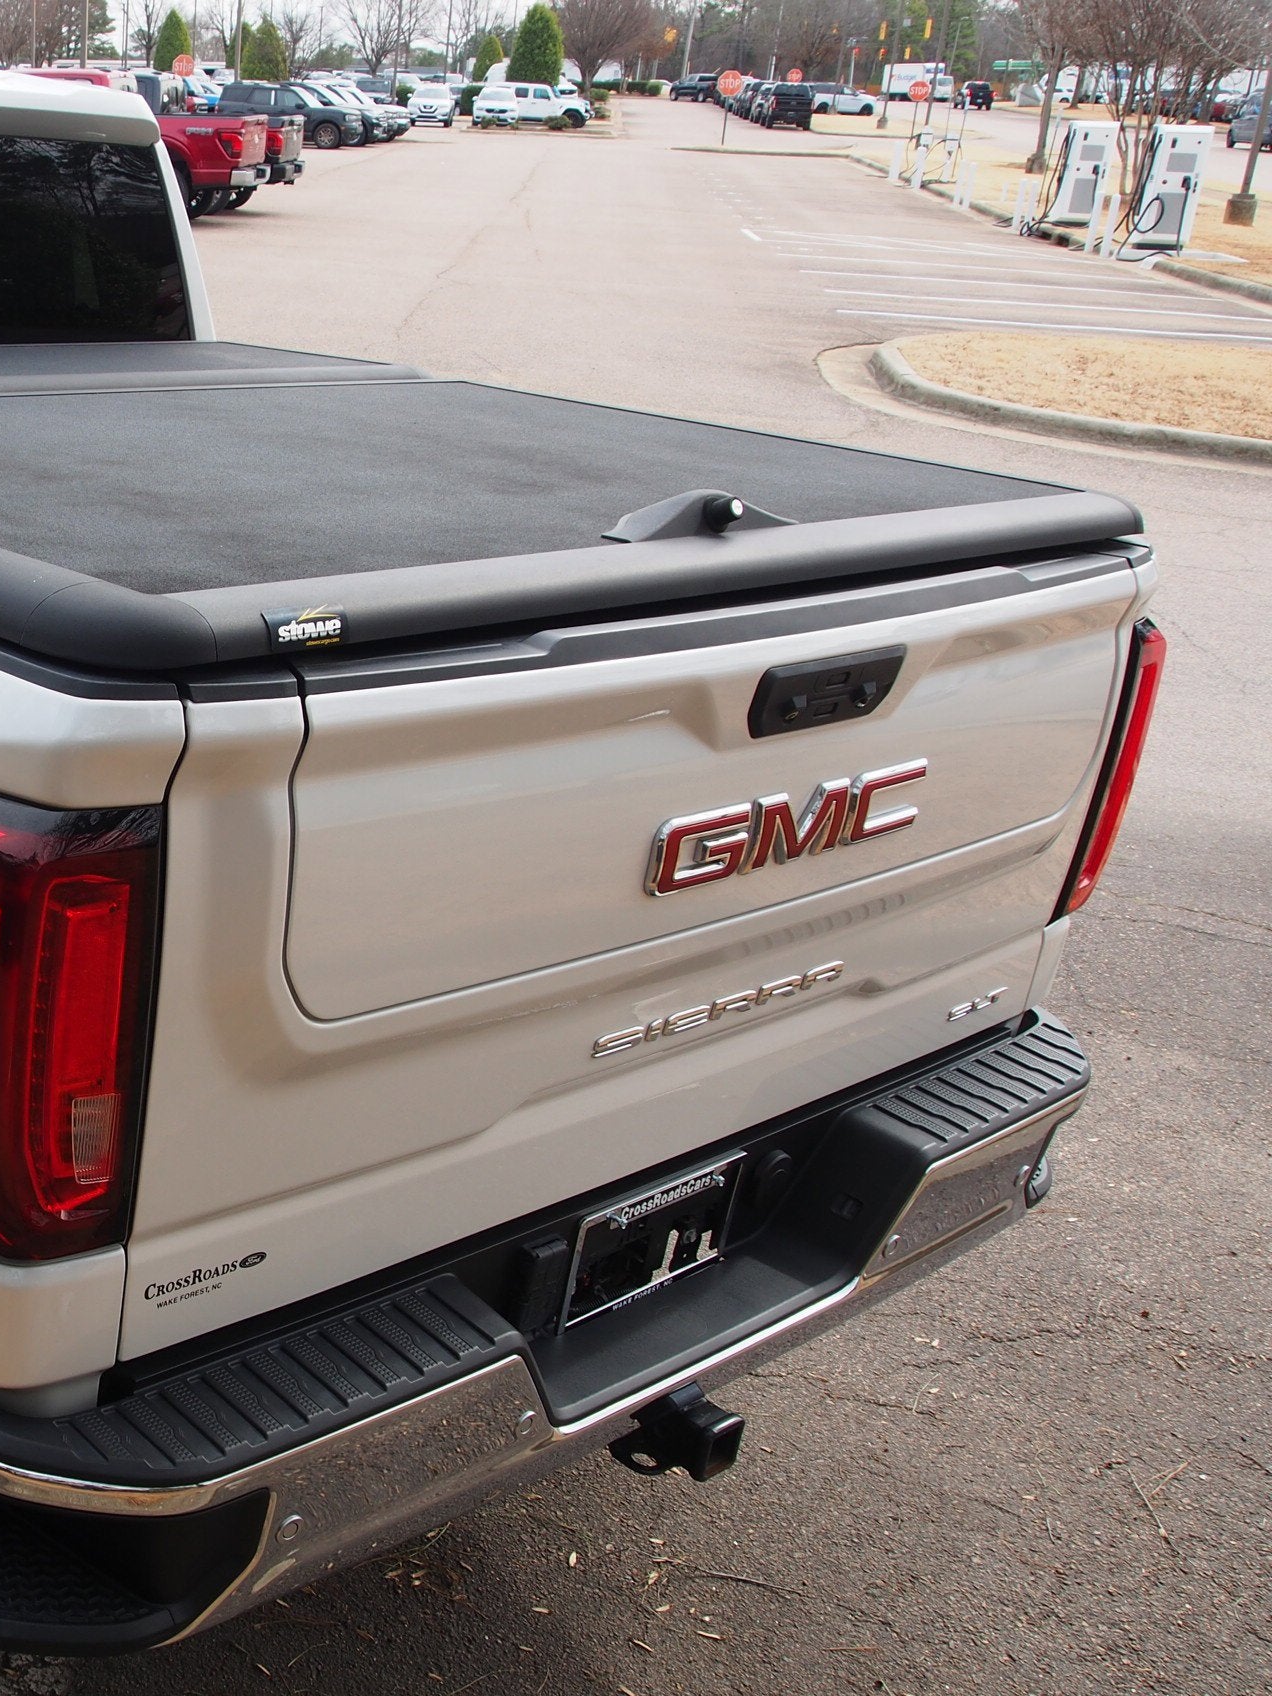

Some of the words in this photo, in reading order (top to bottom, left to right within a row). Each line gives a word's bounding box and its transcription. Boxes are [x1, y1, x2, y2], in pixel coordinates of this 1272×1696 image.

[175, 62, 193, 73] STOP
[720, 78, 742, 89] STOP
[909, 86, 928, 95] STOP
[278, 618, 342, 643] stowe
[644, 757, 928, 897] GMC
[591, 960, 845, 1058] SIERRA
[947, 986, 1008, 1021] SLT
[156, 1297, 178, 1309] WAKE
[179, 1287, 210, 1302] FOREST,
[211, 1282, 223, 1291] NC
[612, 1297, 633, 1310] WAKE
